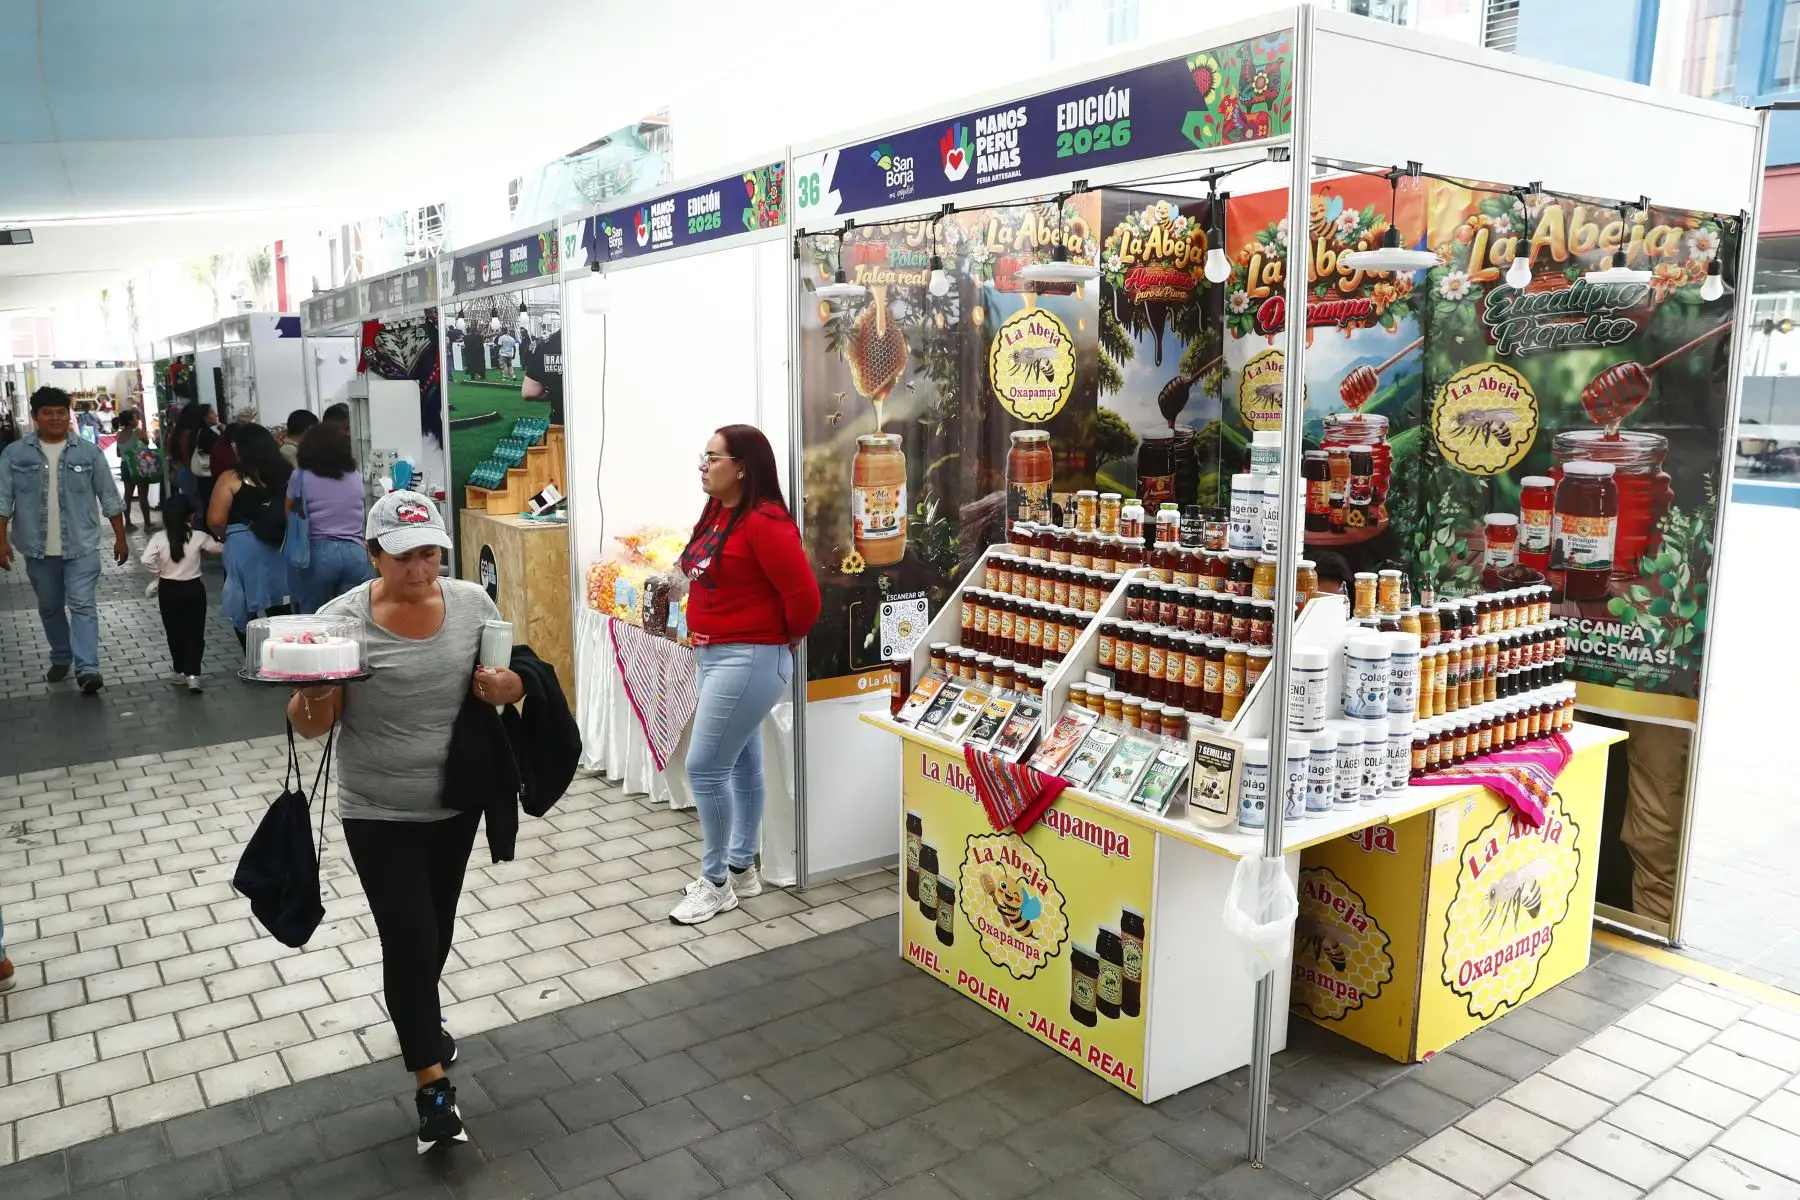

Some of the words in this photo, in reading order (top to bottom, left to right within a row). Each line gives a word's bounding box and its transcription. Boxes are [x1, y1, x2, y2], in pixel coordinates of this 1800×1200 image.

[976, 106, 1028, 137] MANOS
[1057, 86, 1130, 132] EDICIÓN
[976, 128, 1019, 157] PERU
[1056, 119, 1132, 158] 2026
[892, 156, 914, 173] San
[976, 147, 1022, 175] ANAS
[798, 172, 820, 208] 36
[886, 169, 914, 188] Borja
[651, 199, 675, 217] MANOS
[687, 190, 721, 217] EDICIÓN
[611, 226, 623, 238] San
[651, 213, 672, 231] PERU
[688, 211, 721, 234] 2026
[565, 234, 577, 259] 37
[987, 218, 1012, 254] La
[1119, 229, 1143, 264] La
[1142, 224, 1204, 269] Abeja
[1467, 227, 1520, 283] La
[1528, 204, 1684, 272] Abeja
[888, 248, 929, 270] Polen
[850, 264, 896, 286] Jalea
[897, 269, 929, 286] real
[1246, 252, 1283, 299] La
[1483, 277, 1650, 326] Eucalipto
[1004, 328, 1023, 346] La
[1028, 322, 1061, 348] Abeja
[1247, 366, 1263, 380] La
[1009, 386, 1057, 401] Oxapampa
[1450, 383, 1473, 401] La
[1478, 376, 1520, 401] Abeja
[1250, 410, 1283, 422] Oxapam
[1651, 628, 1666, 643] Y
[1620, 643, 1676, 665] MÁS!
[868, 676, 880, 687] La
[1202, 746, 1232, 761] SEMILLAS
[921, 752, 942, 784] La
[972, 846, 994, 865] La
[998, 845, 1049, 896] Abeja
[1467, 837, 1499, 880] La
[1302, 880, 1368, 933] Abeja
[976, 916, 1041, 961] Oxapampa
[1458, 923, 1552, 987] Oxapampa
[908, 941, 942, 974] MIEL
[957, 969, 1010, 1014] POLEN
[1026, 1010, 1083, 1058] JALEA
[1086, 1045, 1138, 1091] REAL
